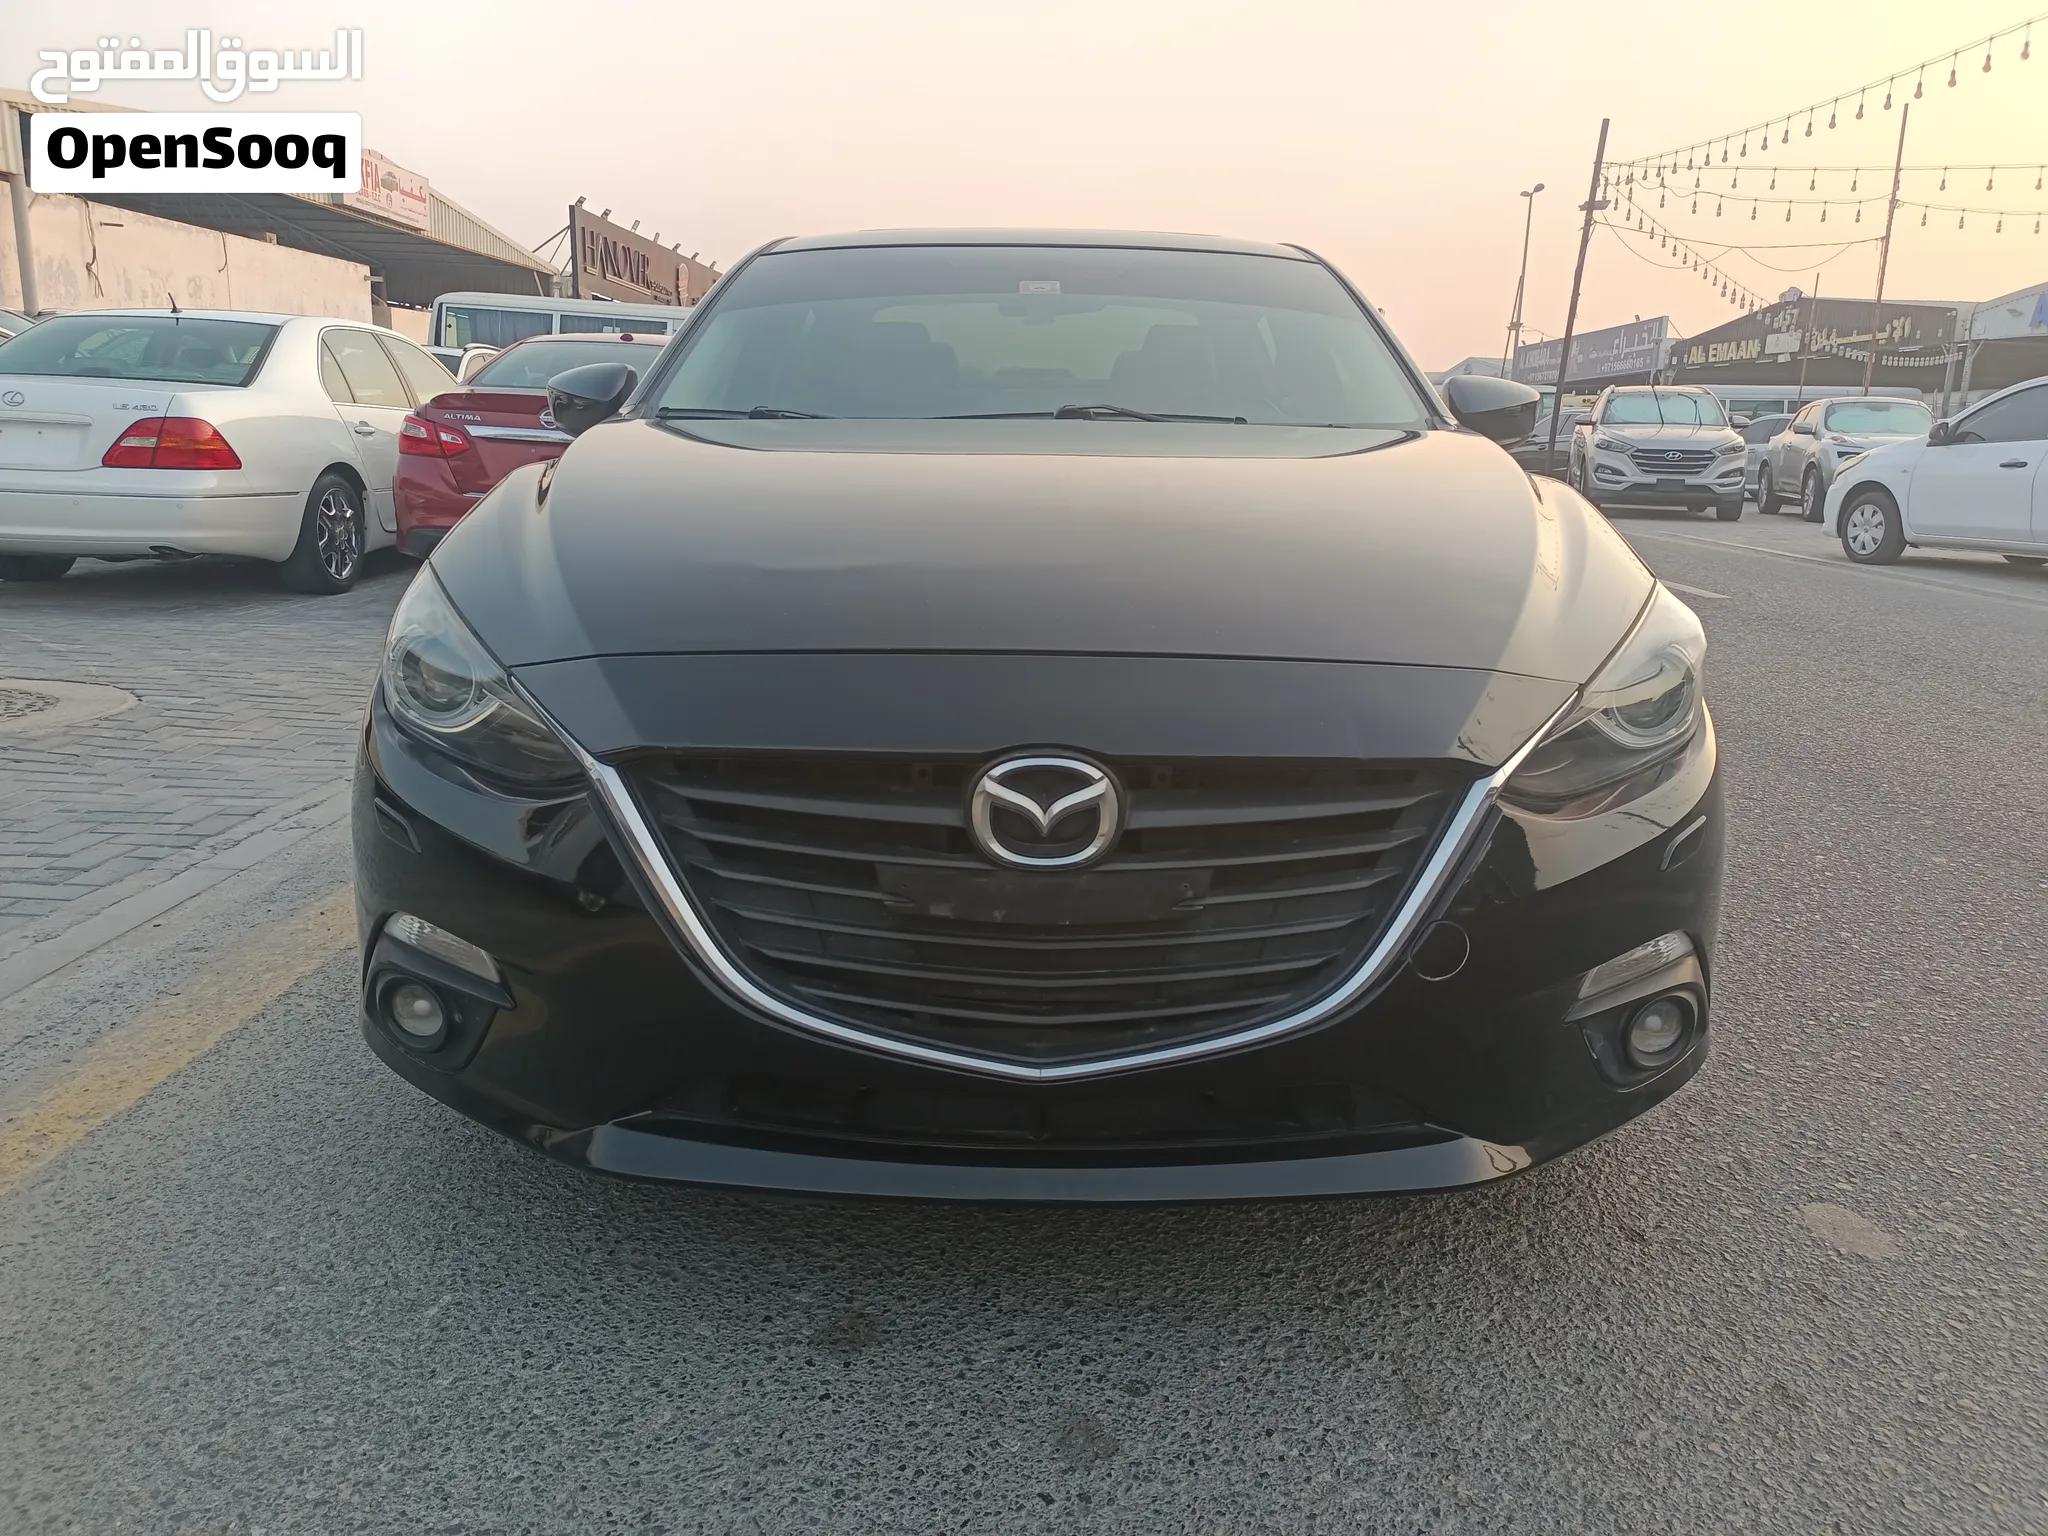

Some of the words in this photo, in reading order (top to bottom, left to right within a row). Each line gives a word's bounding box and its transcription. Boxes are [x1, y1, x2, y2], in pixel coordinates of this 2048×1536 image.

[581, 226, 652, 292] HANOVER
[1688, 345, 1706, 364] AL
[1708, 339, 1760, 363] EMAAN
[112, 403, 130, 411] LS
[131, 404, 159, 412] 430
[443, 413, 482, 421] ALTIMA
